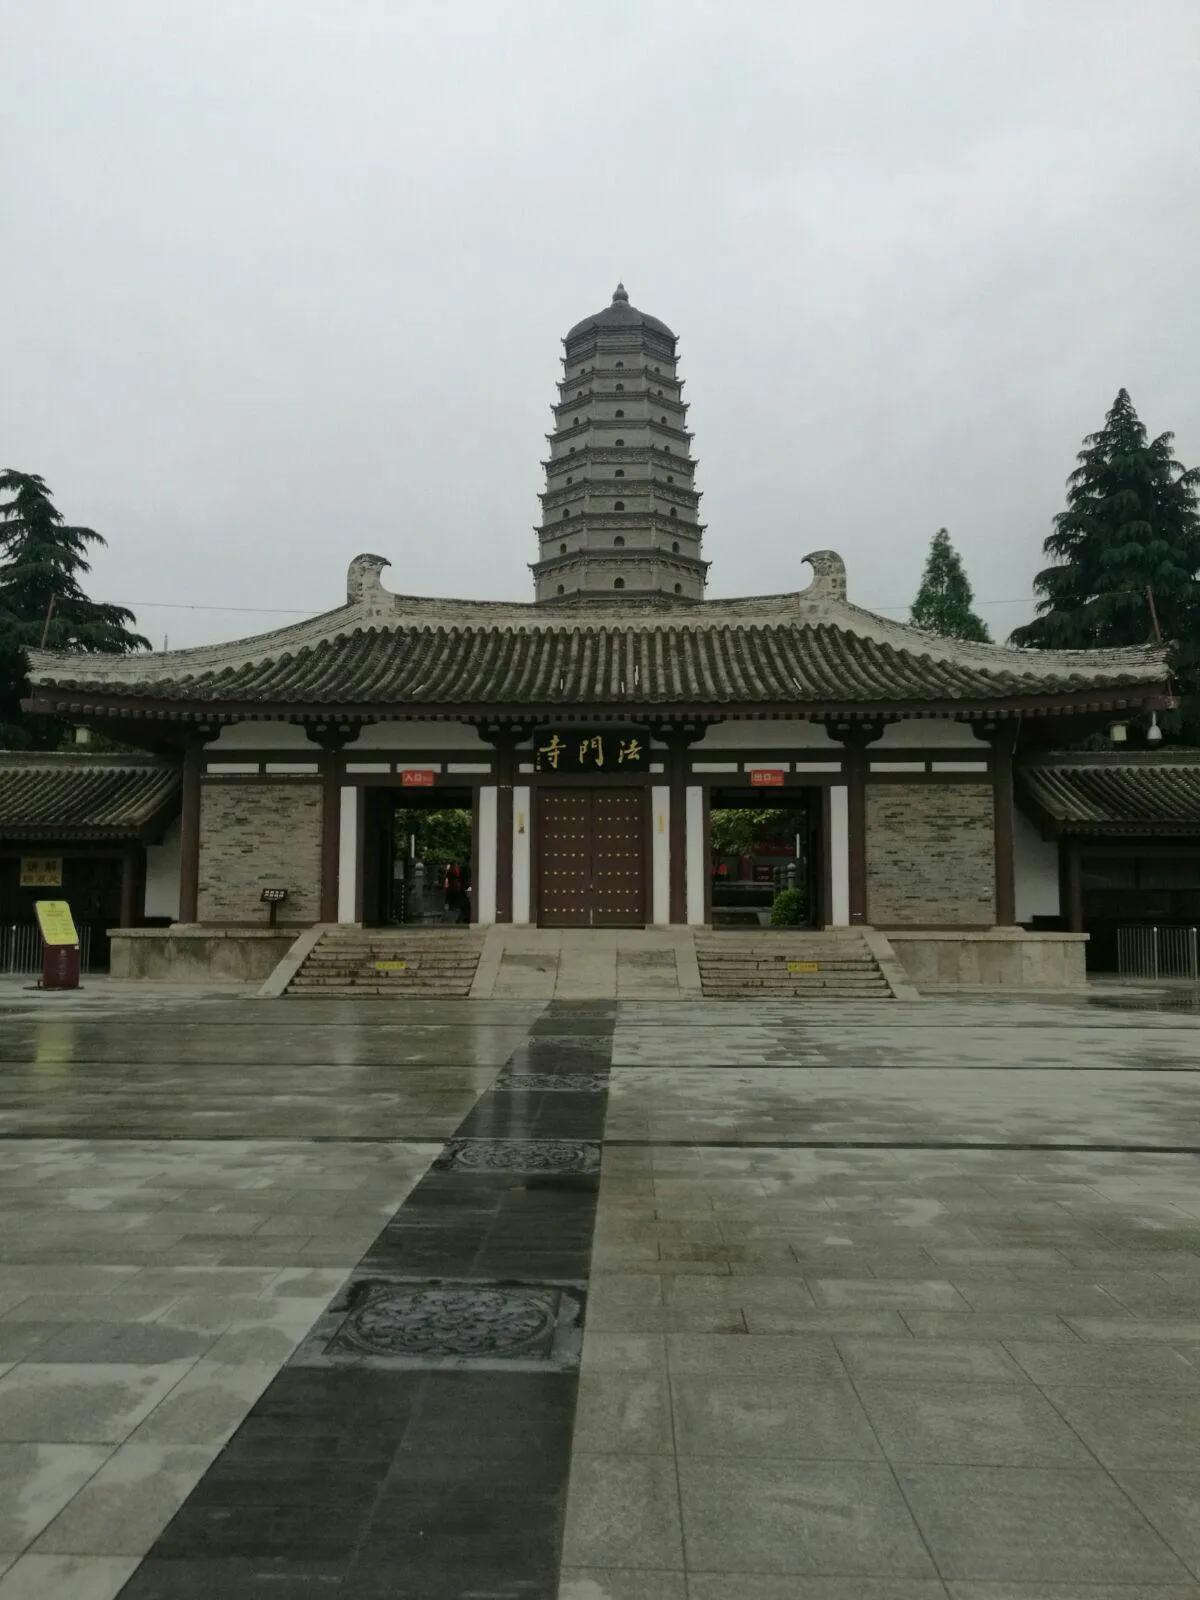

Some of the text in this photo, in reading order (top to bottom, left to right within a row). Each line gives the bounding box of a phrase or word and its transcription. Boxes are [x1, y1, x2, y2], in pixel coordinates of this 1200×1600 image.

[539, 734, 643, 769] 法門寺
[405, 773, 422, 783] 入口
[753, 773, 772, 782] 出口
